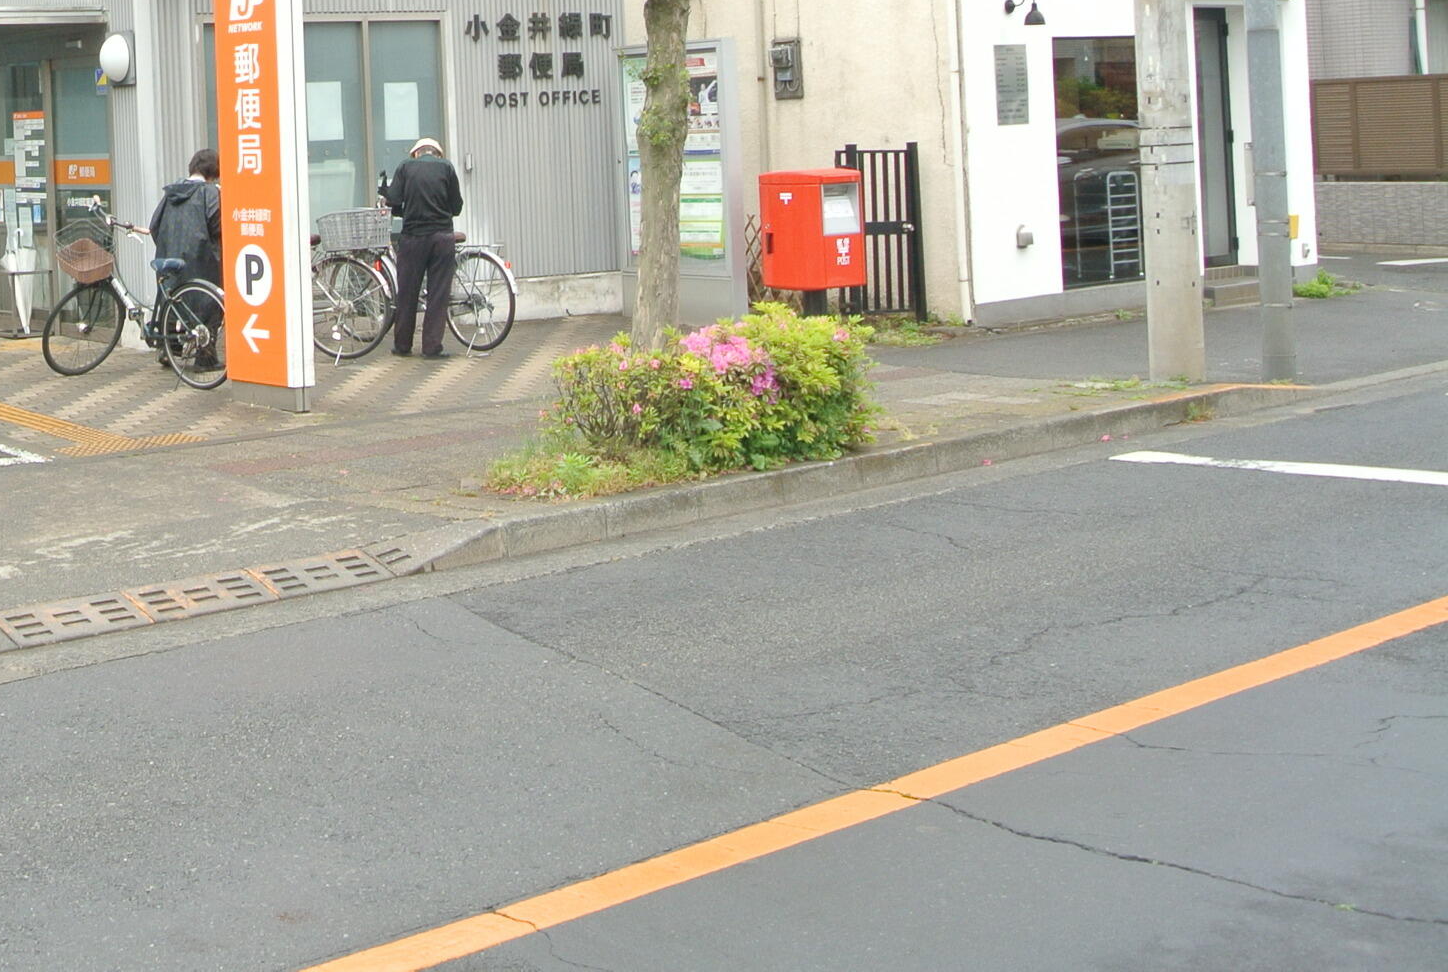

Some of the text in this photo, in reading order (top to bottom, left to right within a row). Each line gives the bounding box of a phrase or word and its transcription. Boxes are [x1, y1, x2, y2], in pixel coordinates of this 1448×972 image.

[228, 21, 263, 33] NETWORK
[464, 12, 612, 43] 小金井緑町
[497, 51, 584, 80] 郵便局
[234, 43, 262, 175] 郵便局
[483, 89, 601, 109] POST OFFICE
[232, 208, 272, 222] 小金井緑町
[240, 223, 264, 236] 郵便局
[245, 254, 264, 295] P
